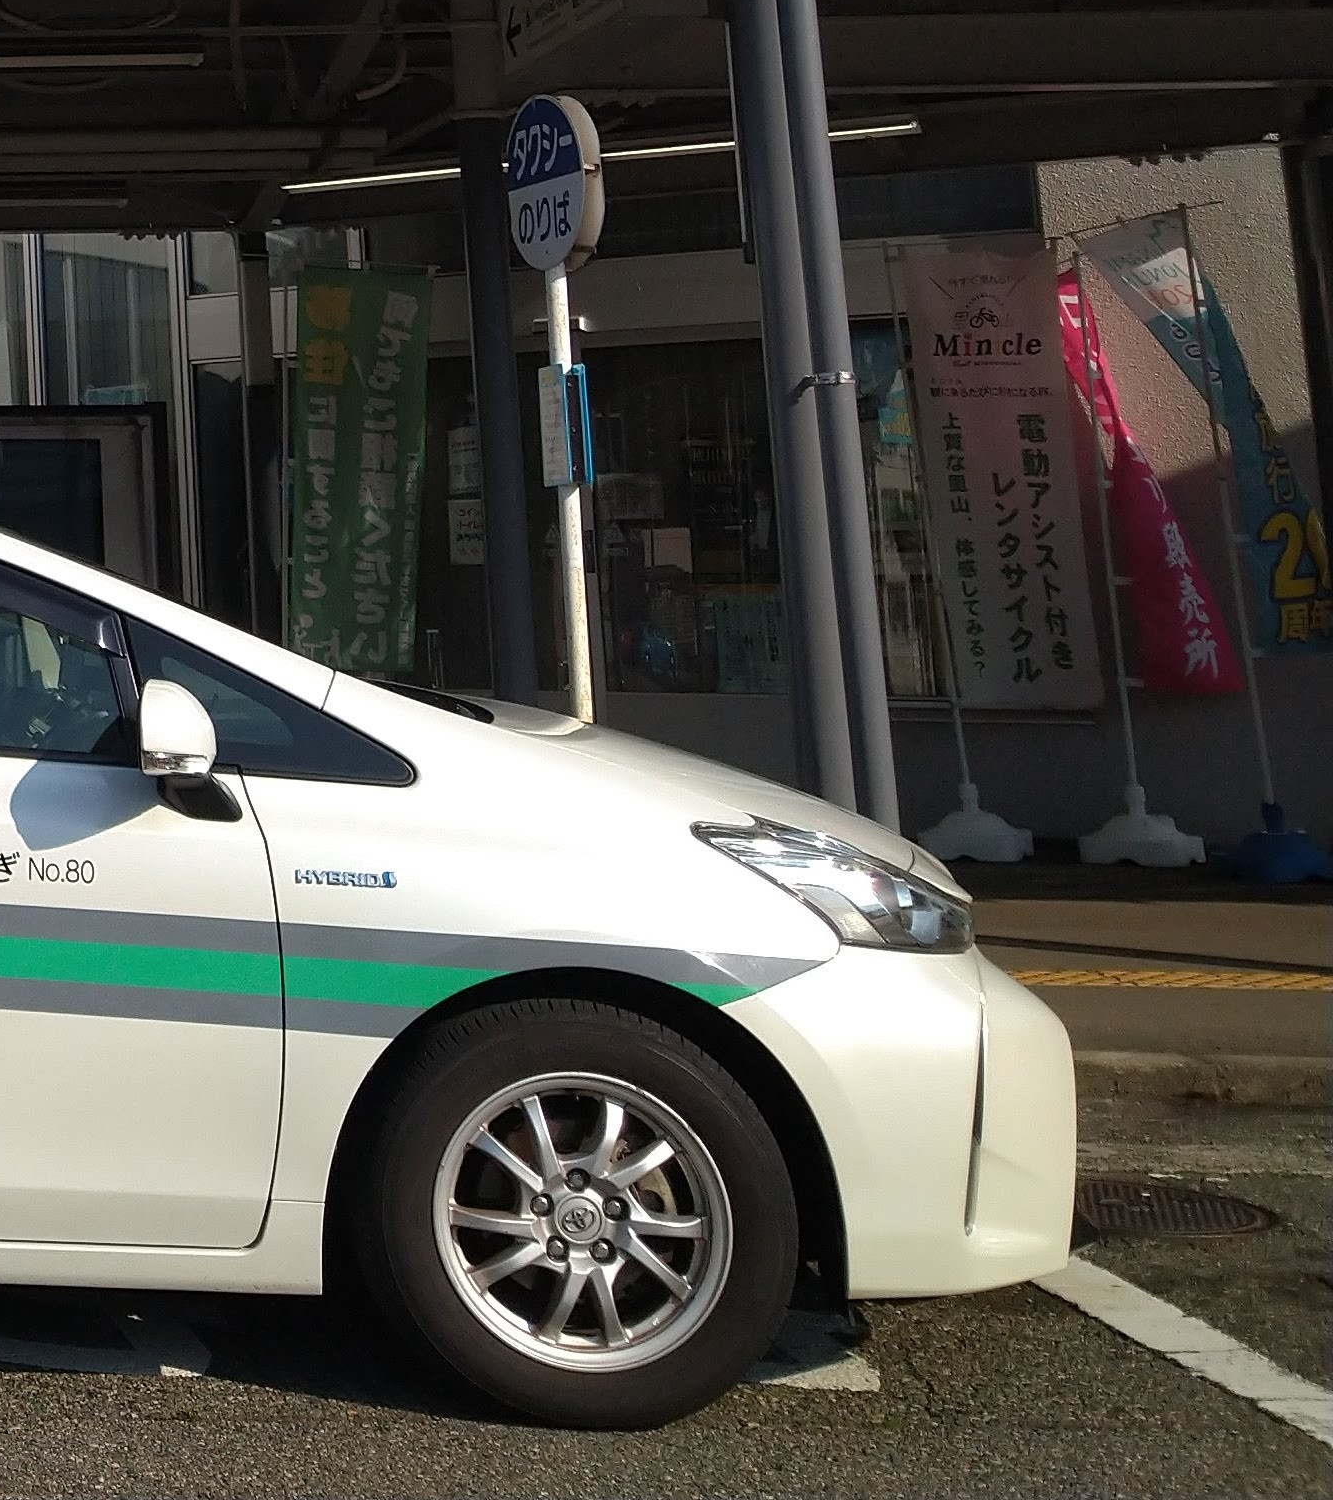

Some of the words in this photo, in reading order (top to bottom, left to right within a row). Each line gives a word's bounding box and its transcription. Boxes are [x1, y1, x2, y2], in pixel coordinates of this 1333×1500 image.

[514, 123, 573, 182] タクシー
[519, 189, 572, 246] のりば
[1016, 414, 1074, 670] 電動アシスト付き
[992, 471, 1043, 684] レンタサイクル
[28, 856, 96, 885] No.80
[294, 868, 381, 888] HYBRID
